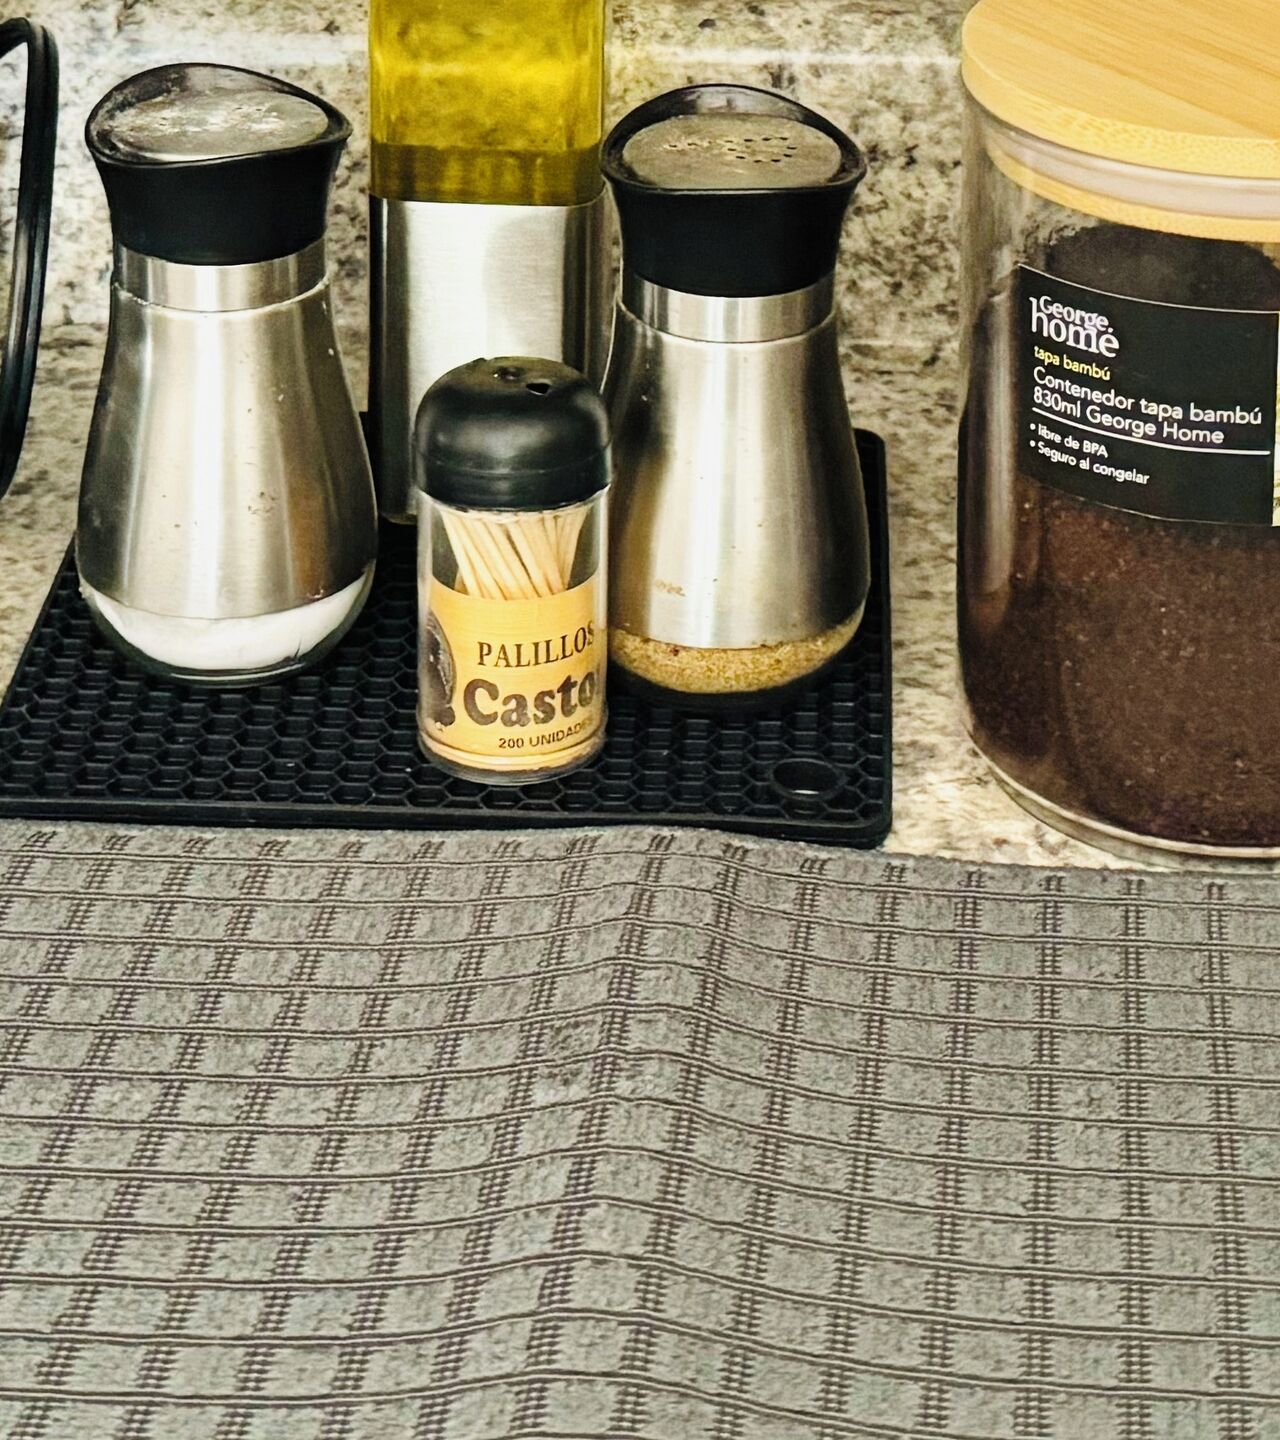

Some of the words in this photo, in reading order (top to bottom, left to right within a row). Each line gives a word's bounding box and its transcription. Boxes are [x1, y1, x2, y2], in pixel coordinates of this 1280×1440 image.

[1029, 296, 1120, 358] home
[1034, 345, 1060, 366] tapa
[1063, 353, 1111, 381] bambú
[1033, 365, 1136, 410] Contenedor
[1139, 398, 1183, 422] tapa
[1189, 402, 1262, 424] bambú
[1033, 385, 1081, 418] 830ml
[1086, 405, 1157, 438] George
[1162, 420, 1224, 444] Home
[1037, 423, 1062, 443] libre
[1064, 435, 1080, 450] de
[1082, 440, 1109, 459] BPA
[1037, 441, 1077, 466] Seguro
[1079, 457, 1090, 470] al
[1092, 463, 1150, 484] congelar
[477, 620, 596, 668] PALILLOS
[498, 737, 524, 749] 200
